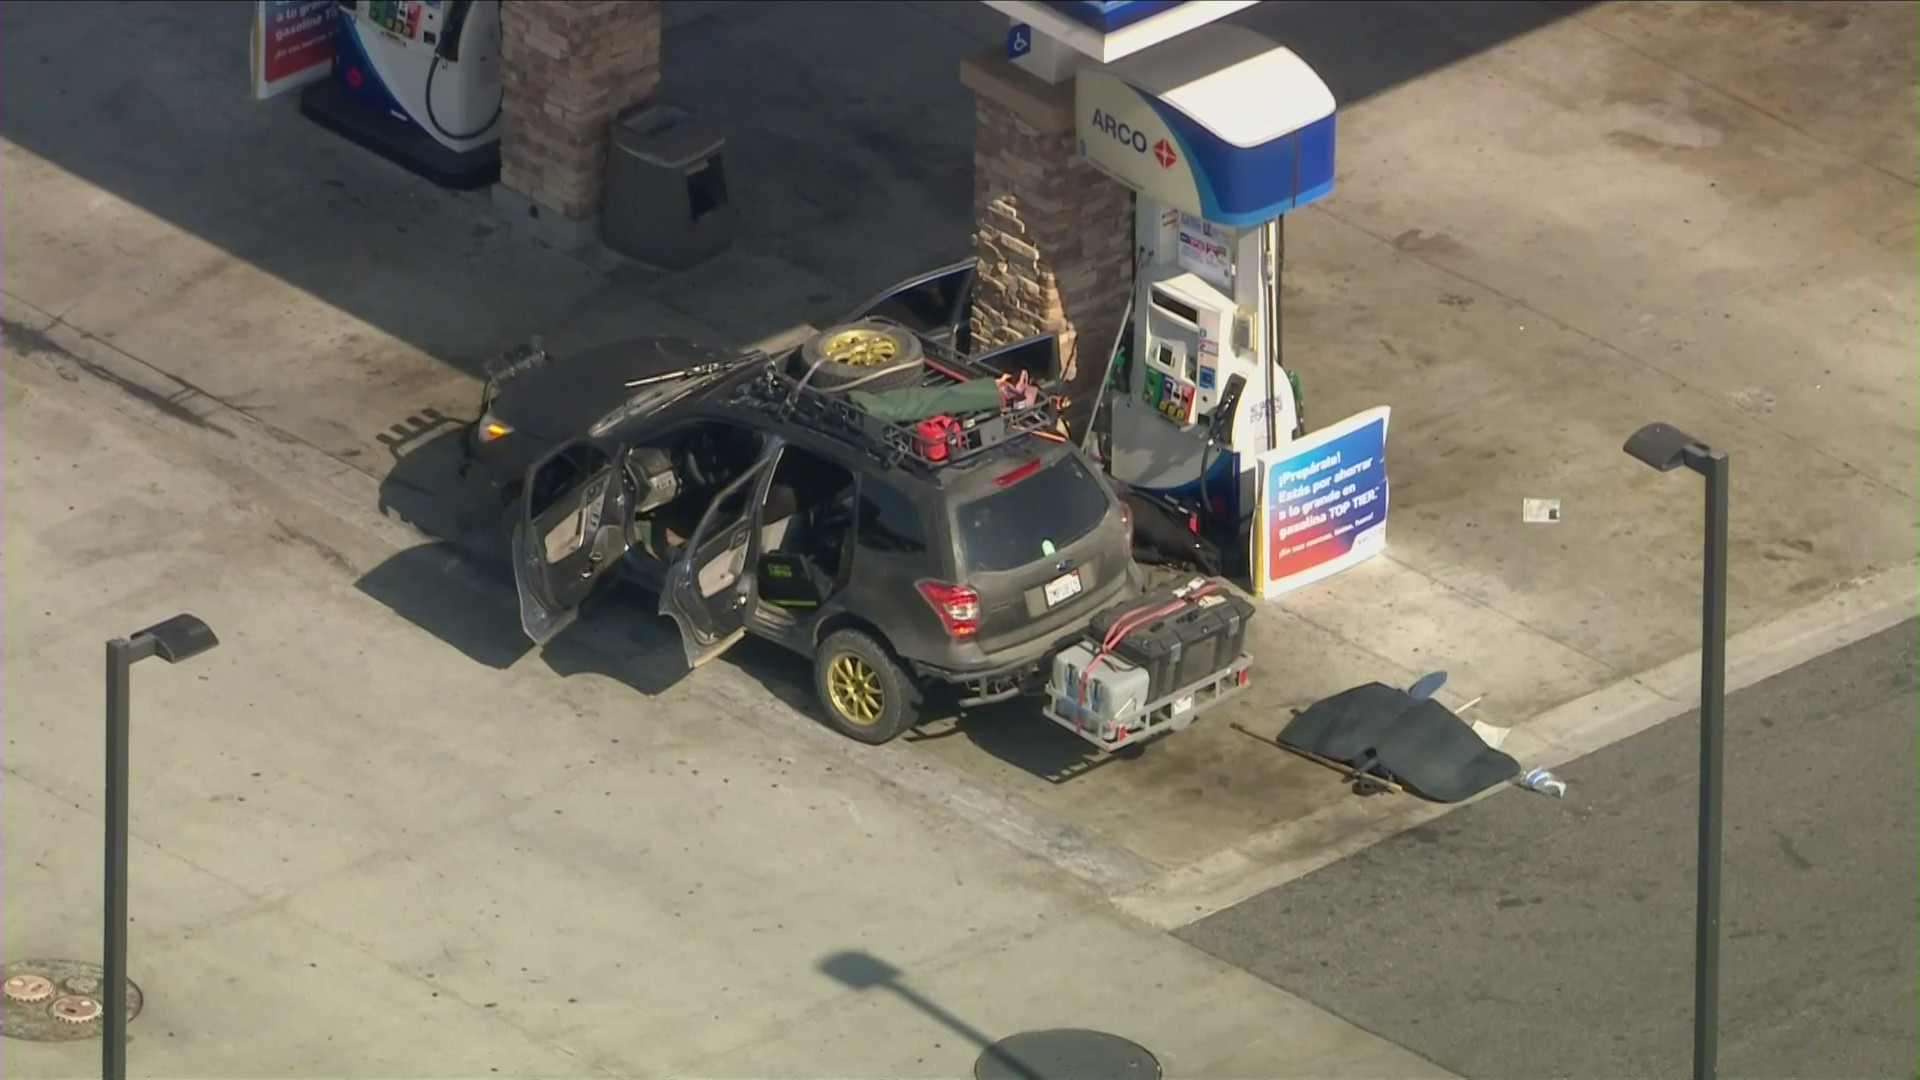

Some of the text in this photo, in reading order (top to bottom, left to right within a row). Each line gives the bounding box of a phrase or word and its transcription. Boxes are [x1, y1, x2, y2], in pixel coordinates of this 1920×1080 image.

[1092, 108, 1147, 153] ARCO
[1279, 451, 1341, 487] ¡Prepárate!
[1279, 457, 1373, 503] Estás por ahorrar
[1279, 483, 1356, 521] a lo grande en
[1279, 513, 1327, 540] gasolina
[1329, 500, 1351, 520] TOP
